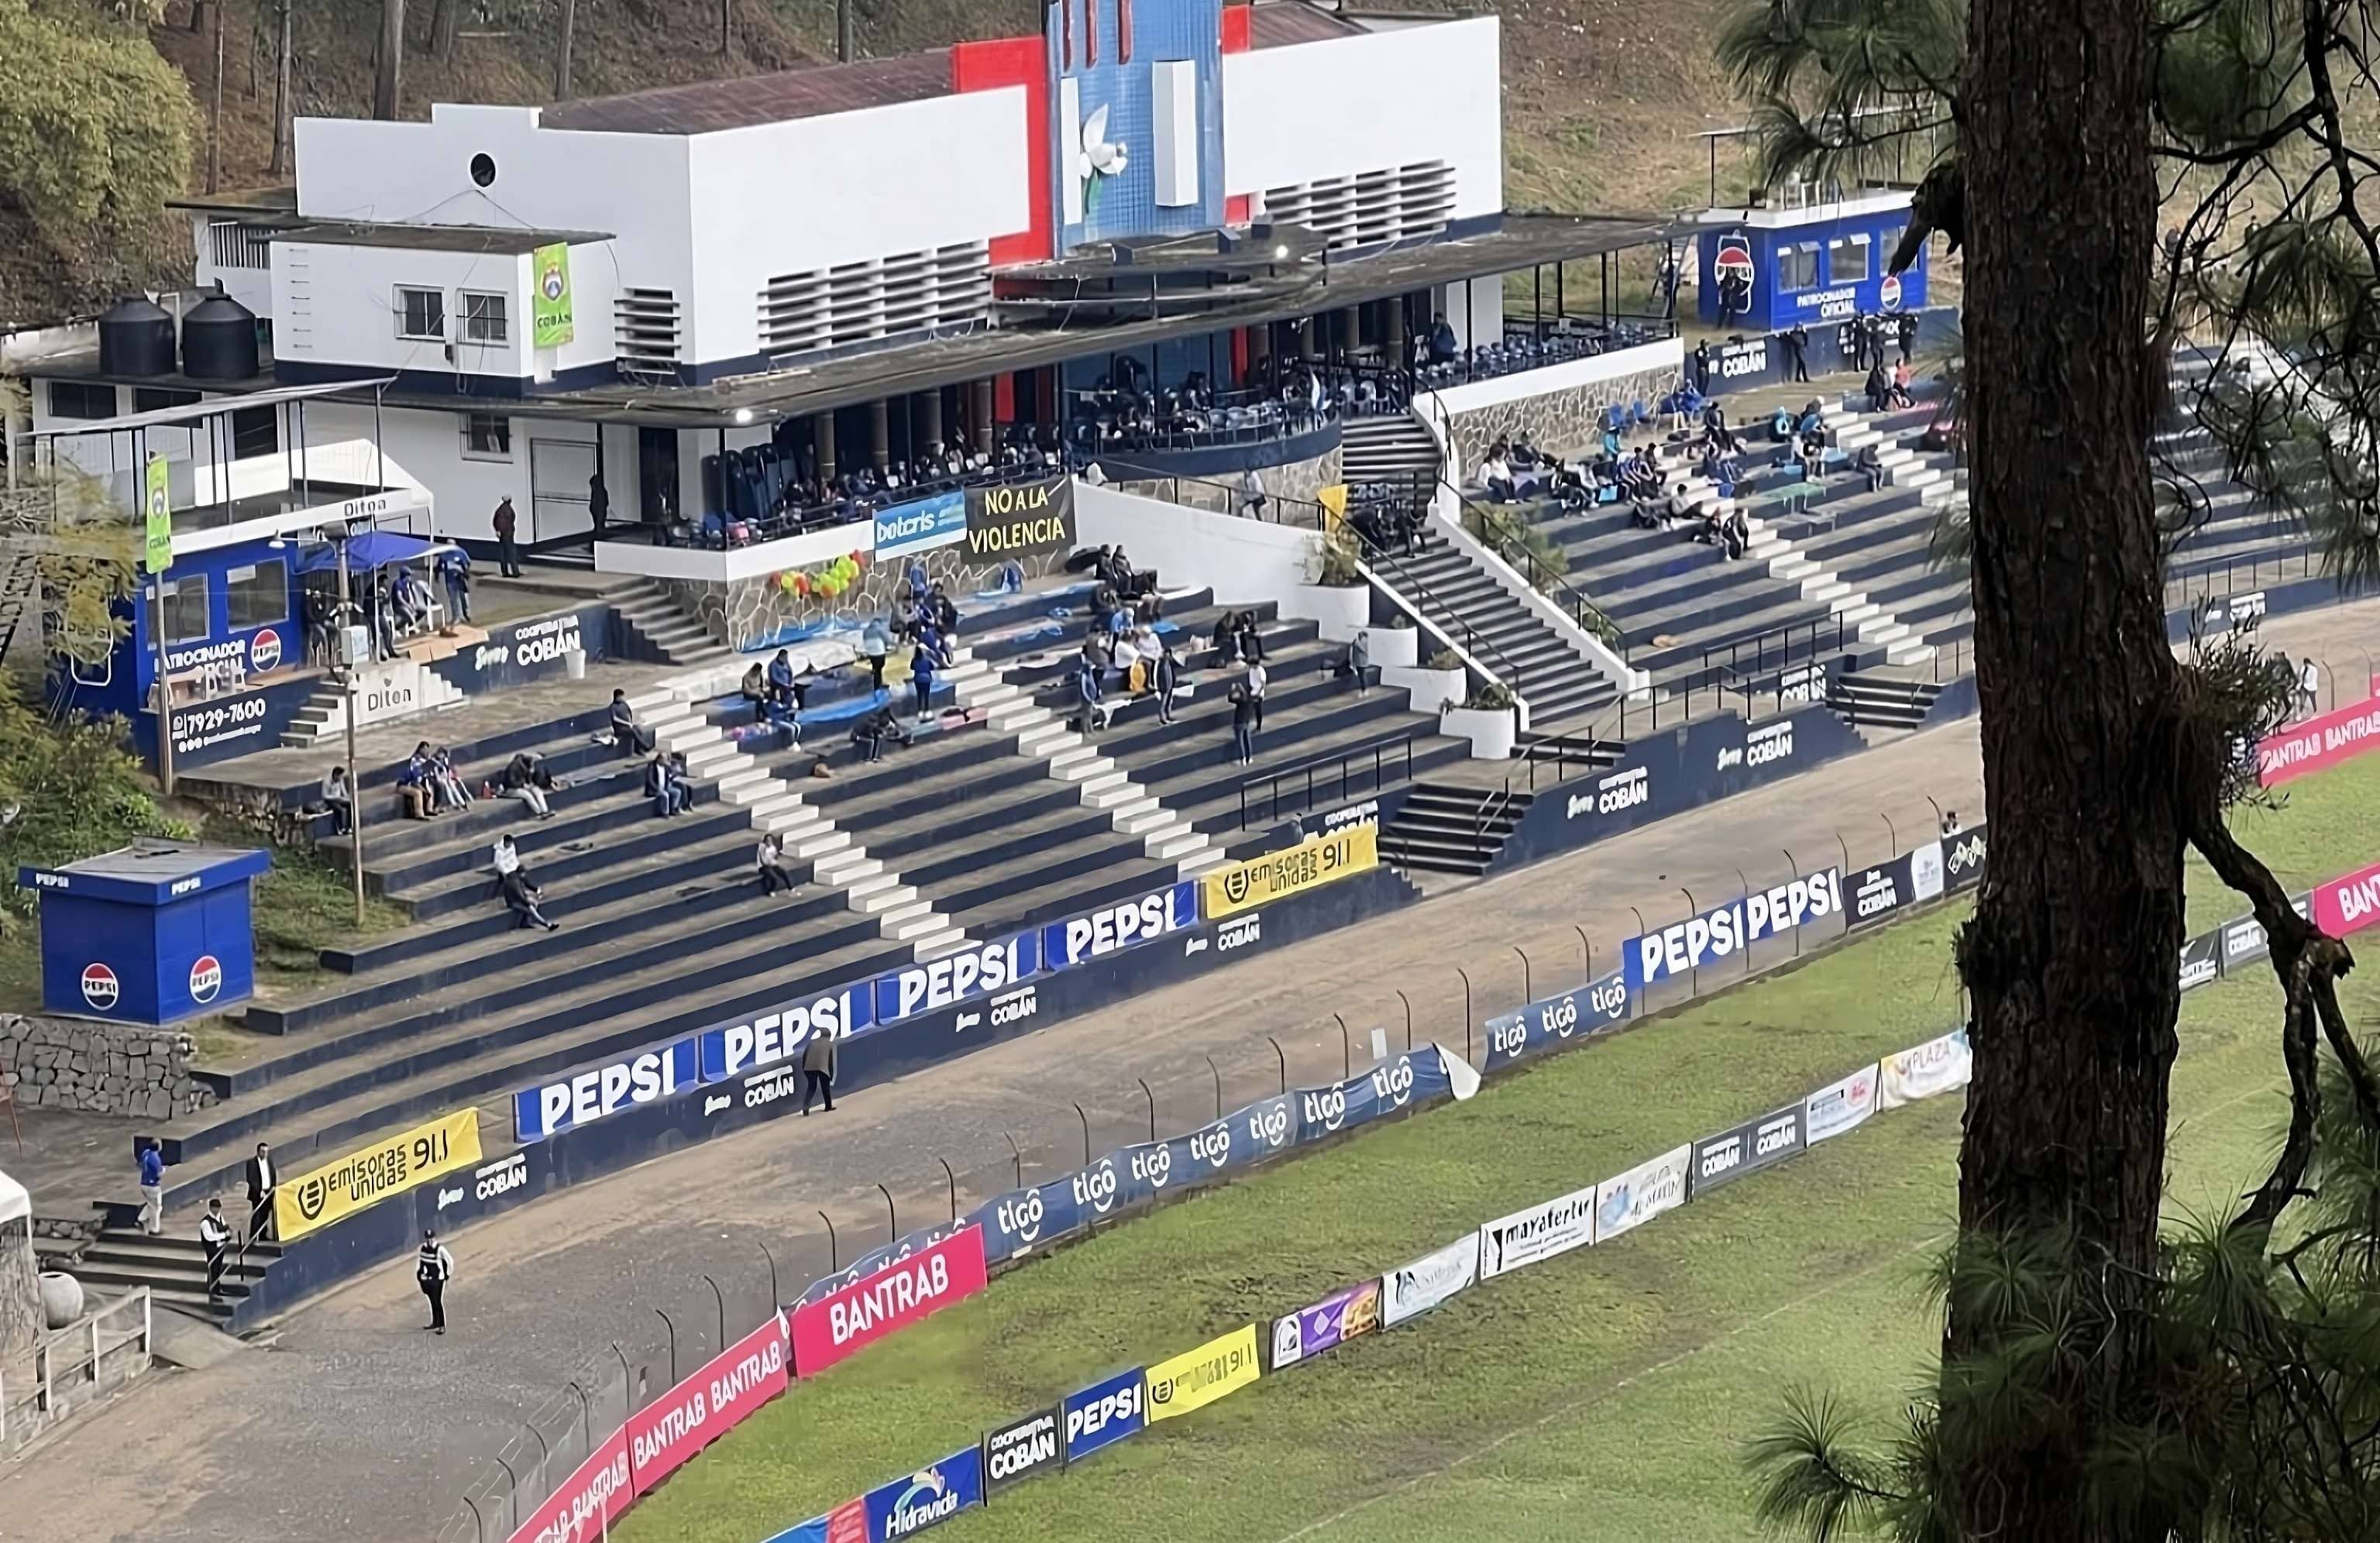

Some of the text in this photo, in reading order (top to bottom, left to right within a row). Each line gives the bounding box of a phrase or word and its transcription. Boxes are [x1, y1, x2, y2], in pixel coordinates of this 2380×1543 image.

[985, 486, 1048, 515] NO A LA
[969, 517, 1066, 554] VIOLENCIA
[517, 626, 580, 666] COBÁN
[187, 698, 267, 735] 7929-7600
[1599, 775, 1648, 814] COBÁN
[36, 873, 69, 888] PEPSI
[172, 877, 201, 896] PEPSI
[1747, 867, 1843, 940] PEPSI
[1066, 888, 1177, 964] PEPSI
[1641, 904, 1744, 983] PEPSI
[84, 979, 116, 995] PEPSI
[898, 938, 1018, 1019] PEPSI
[725, 991, 852, 1076] PEPSI
[540, 1046, 676, 1136] PEPSI
[414, 1129, 448, 1171] 91.1
[351, 1162, 407, 1201] unidas
[830, 1254, 949, 1345] BANTRAB
[633, 1341, 781, 1470] BANTRAB BANTRAB
[1067, 1383, 1142, 1444] PEPSI
[989, 1431, 1055, 1480] COBÁN
[886, 1489, 958, 1539] Hidravida
